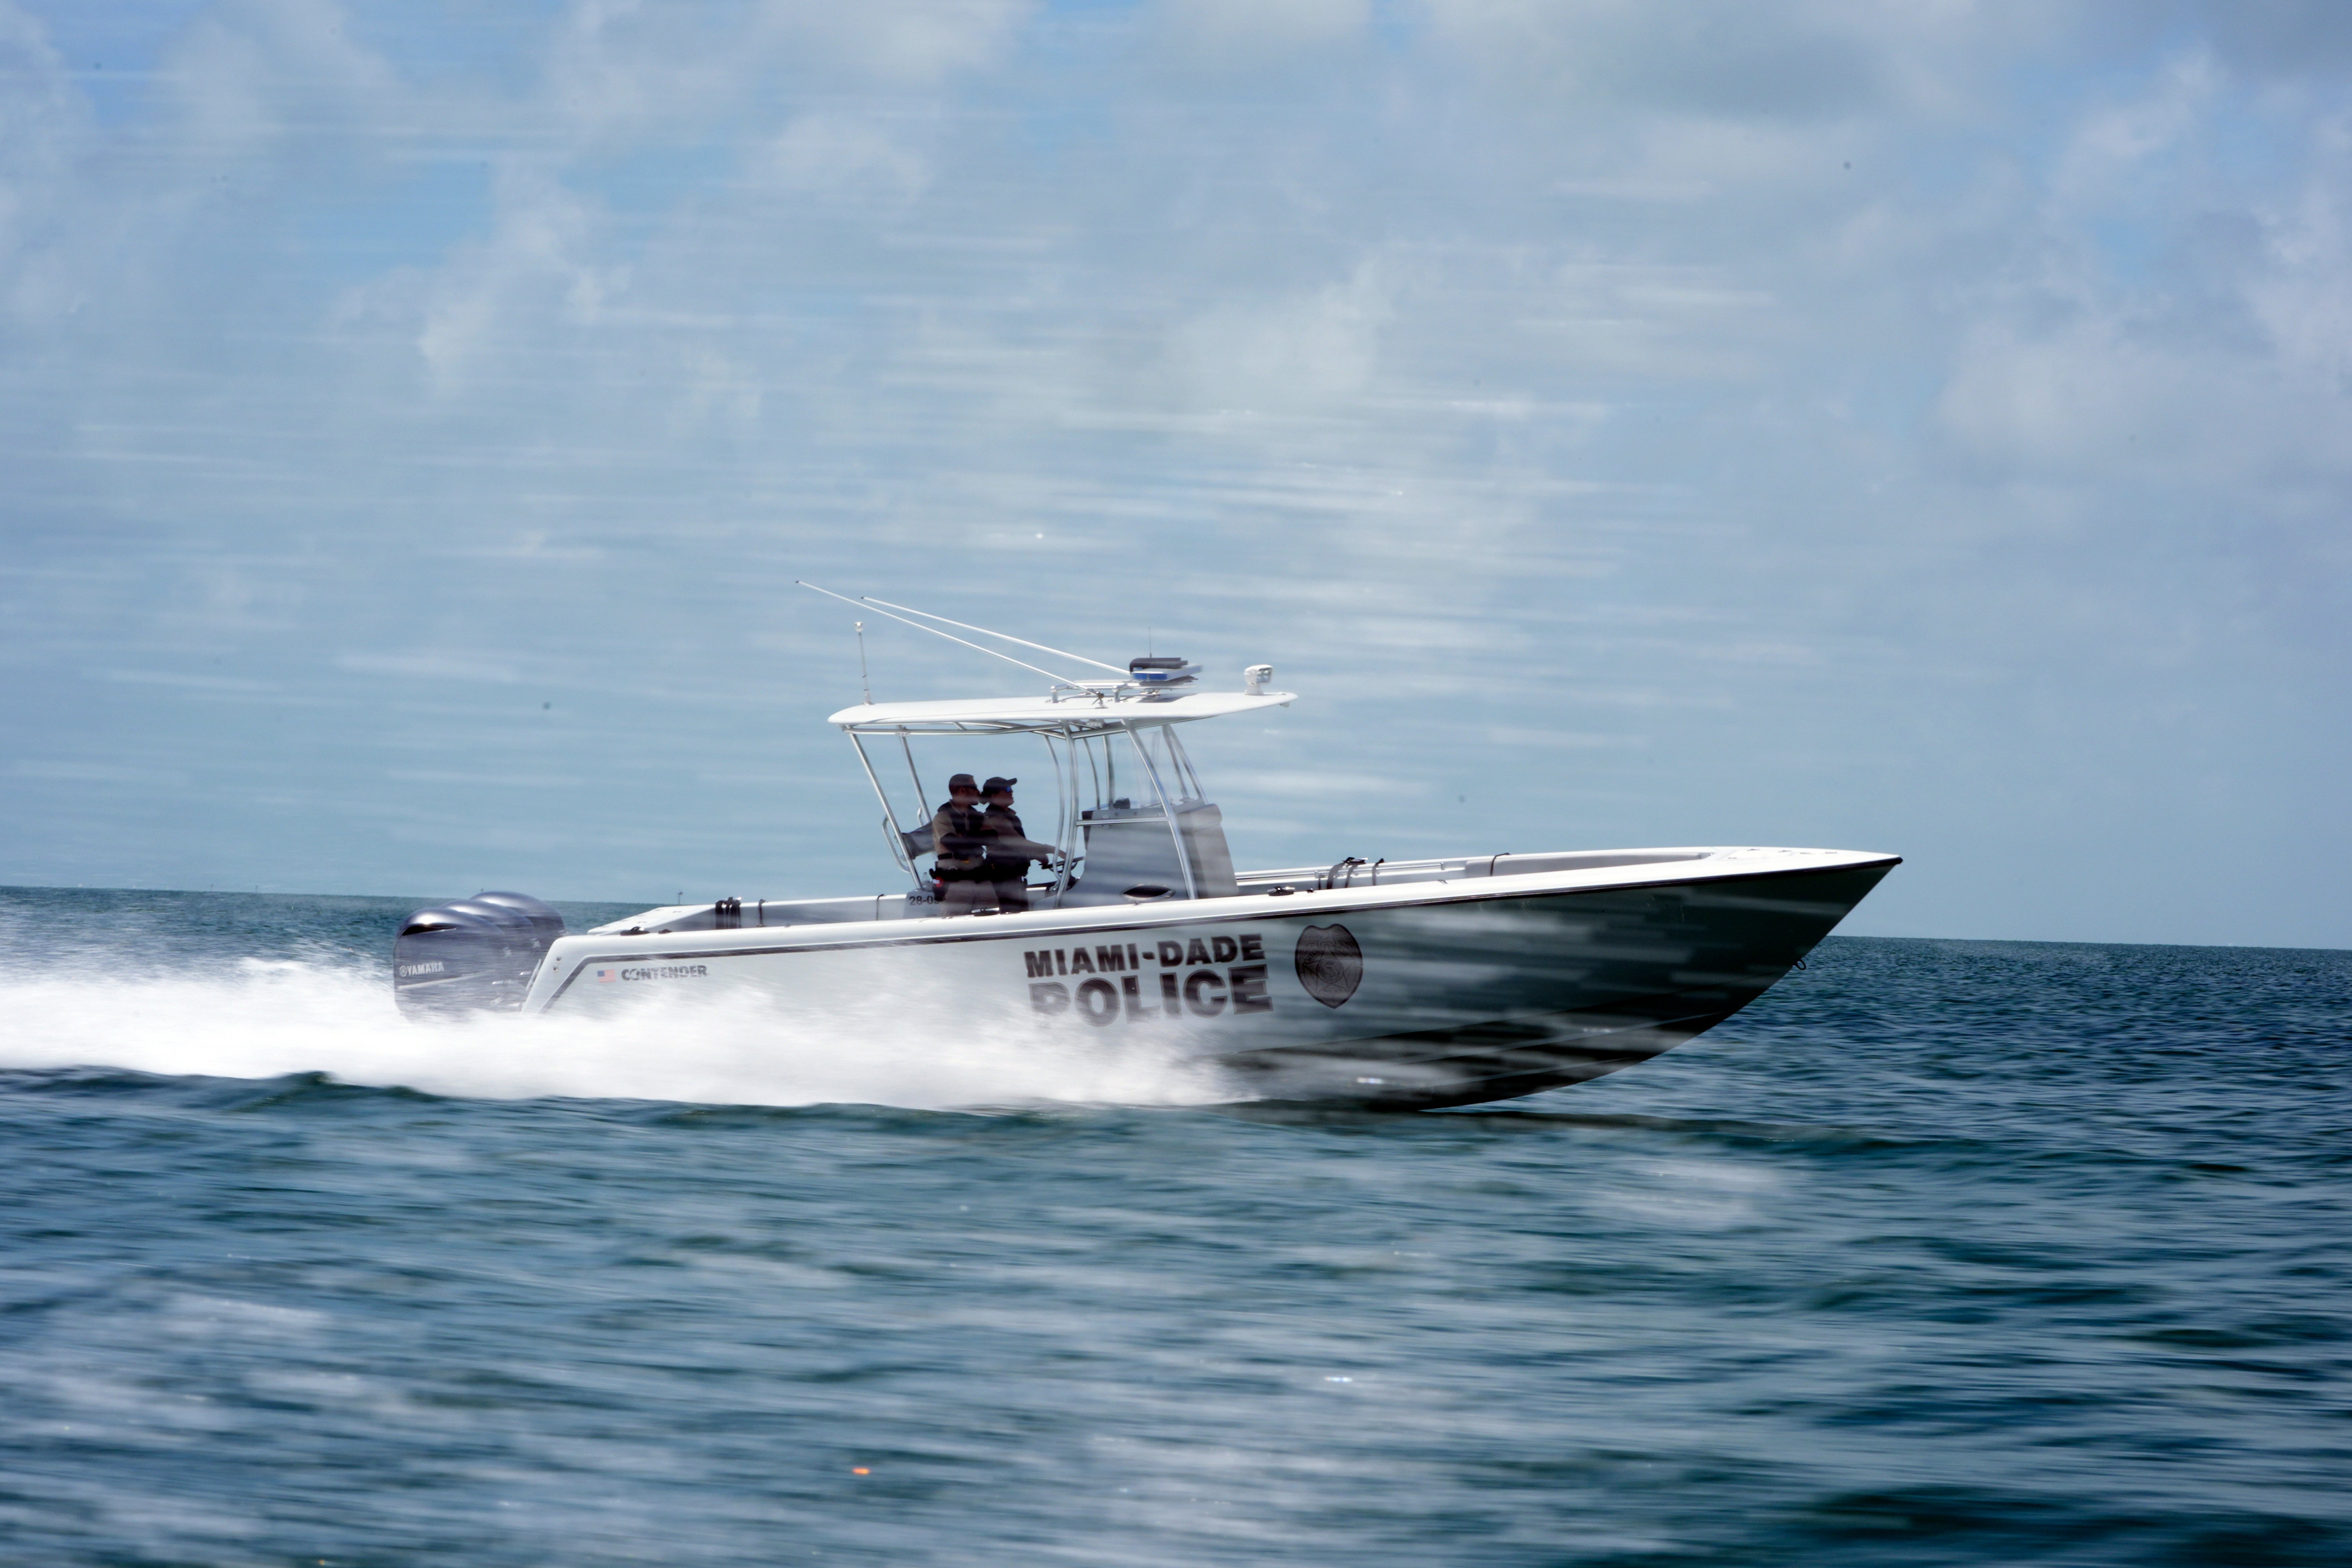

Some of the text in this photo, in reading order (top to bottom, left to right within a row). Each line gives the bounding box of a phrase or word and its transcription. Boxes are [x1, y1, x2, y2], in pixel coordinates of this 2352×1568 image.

[407, 961, 445, 976] YAMAHA
[1024, 934, 1265, 978] MIAMI-DADE
[621, 965, 708, 981] CONTENDER
[1029, 964, 1273, 1027] POLICE
